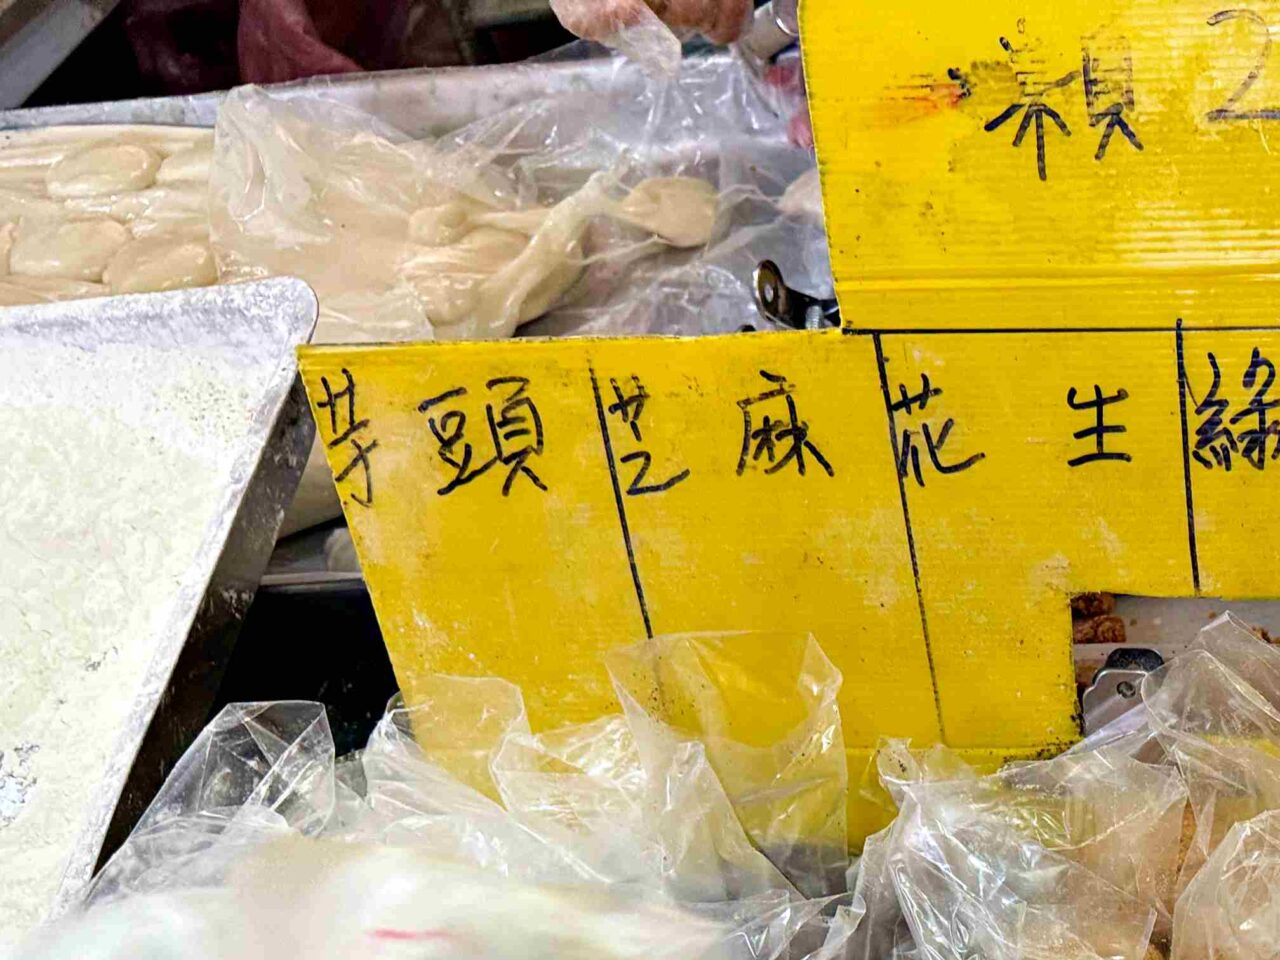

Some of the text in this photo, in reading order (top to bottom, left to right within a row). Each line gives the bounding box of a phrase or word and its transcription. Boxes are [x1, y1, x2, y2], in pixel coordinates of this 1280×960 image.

[316, 367, 549, 508] 芋頭
[608, 368, 836, 497] 芝麻
[890, 372, 1132, 487] 花生
